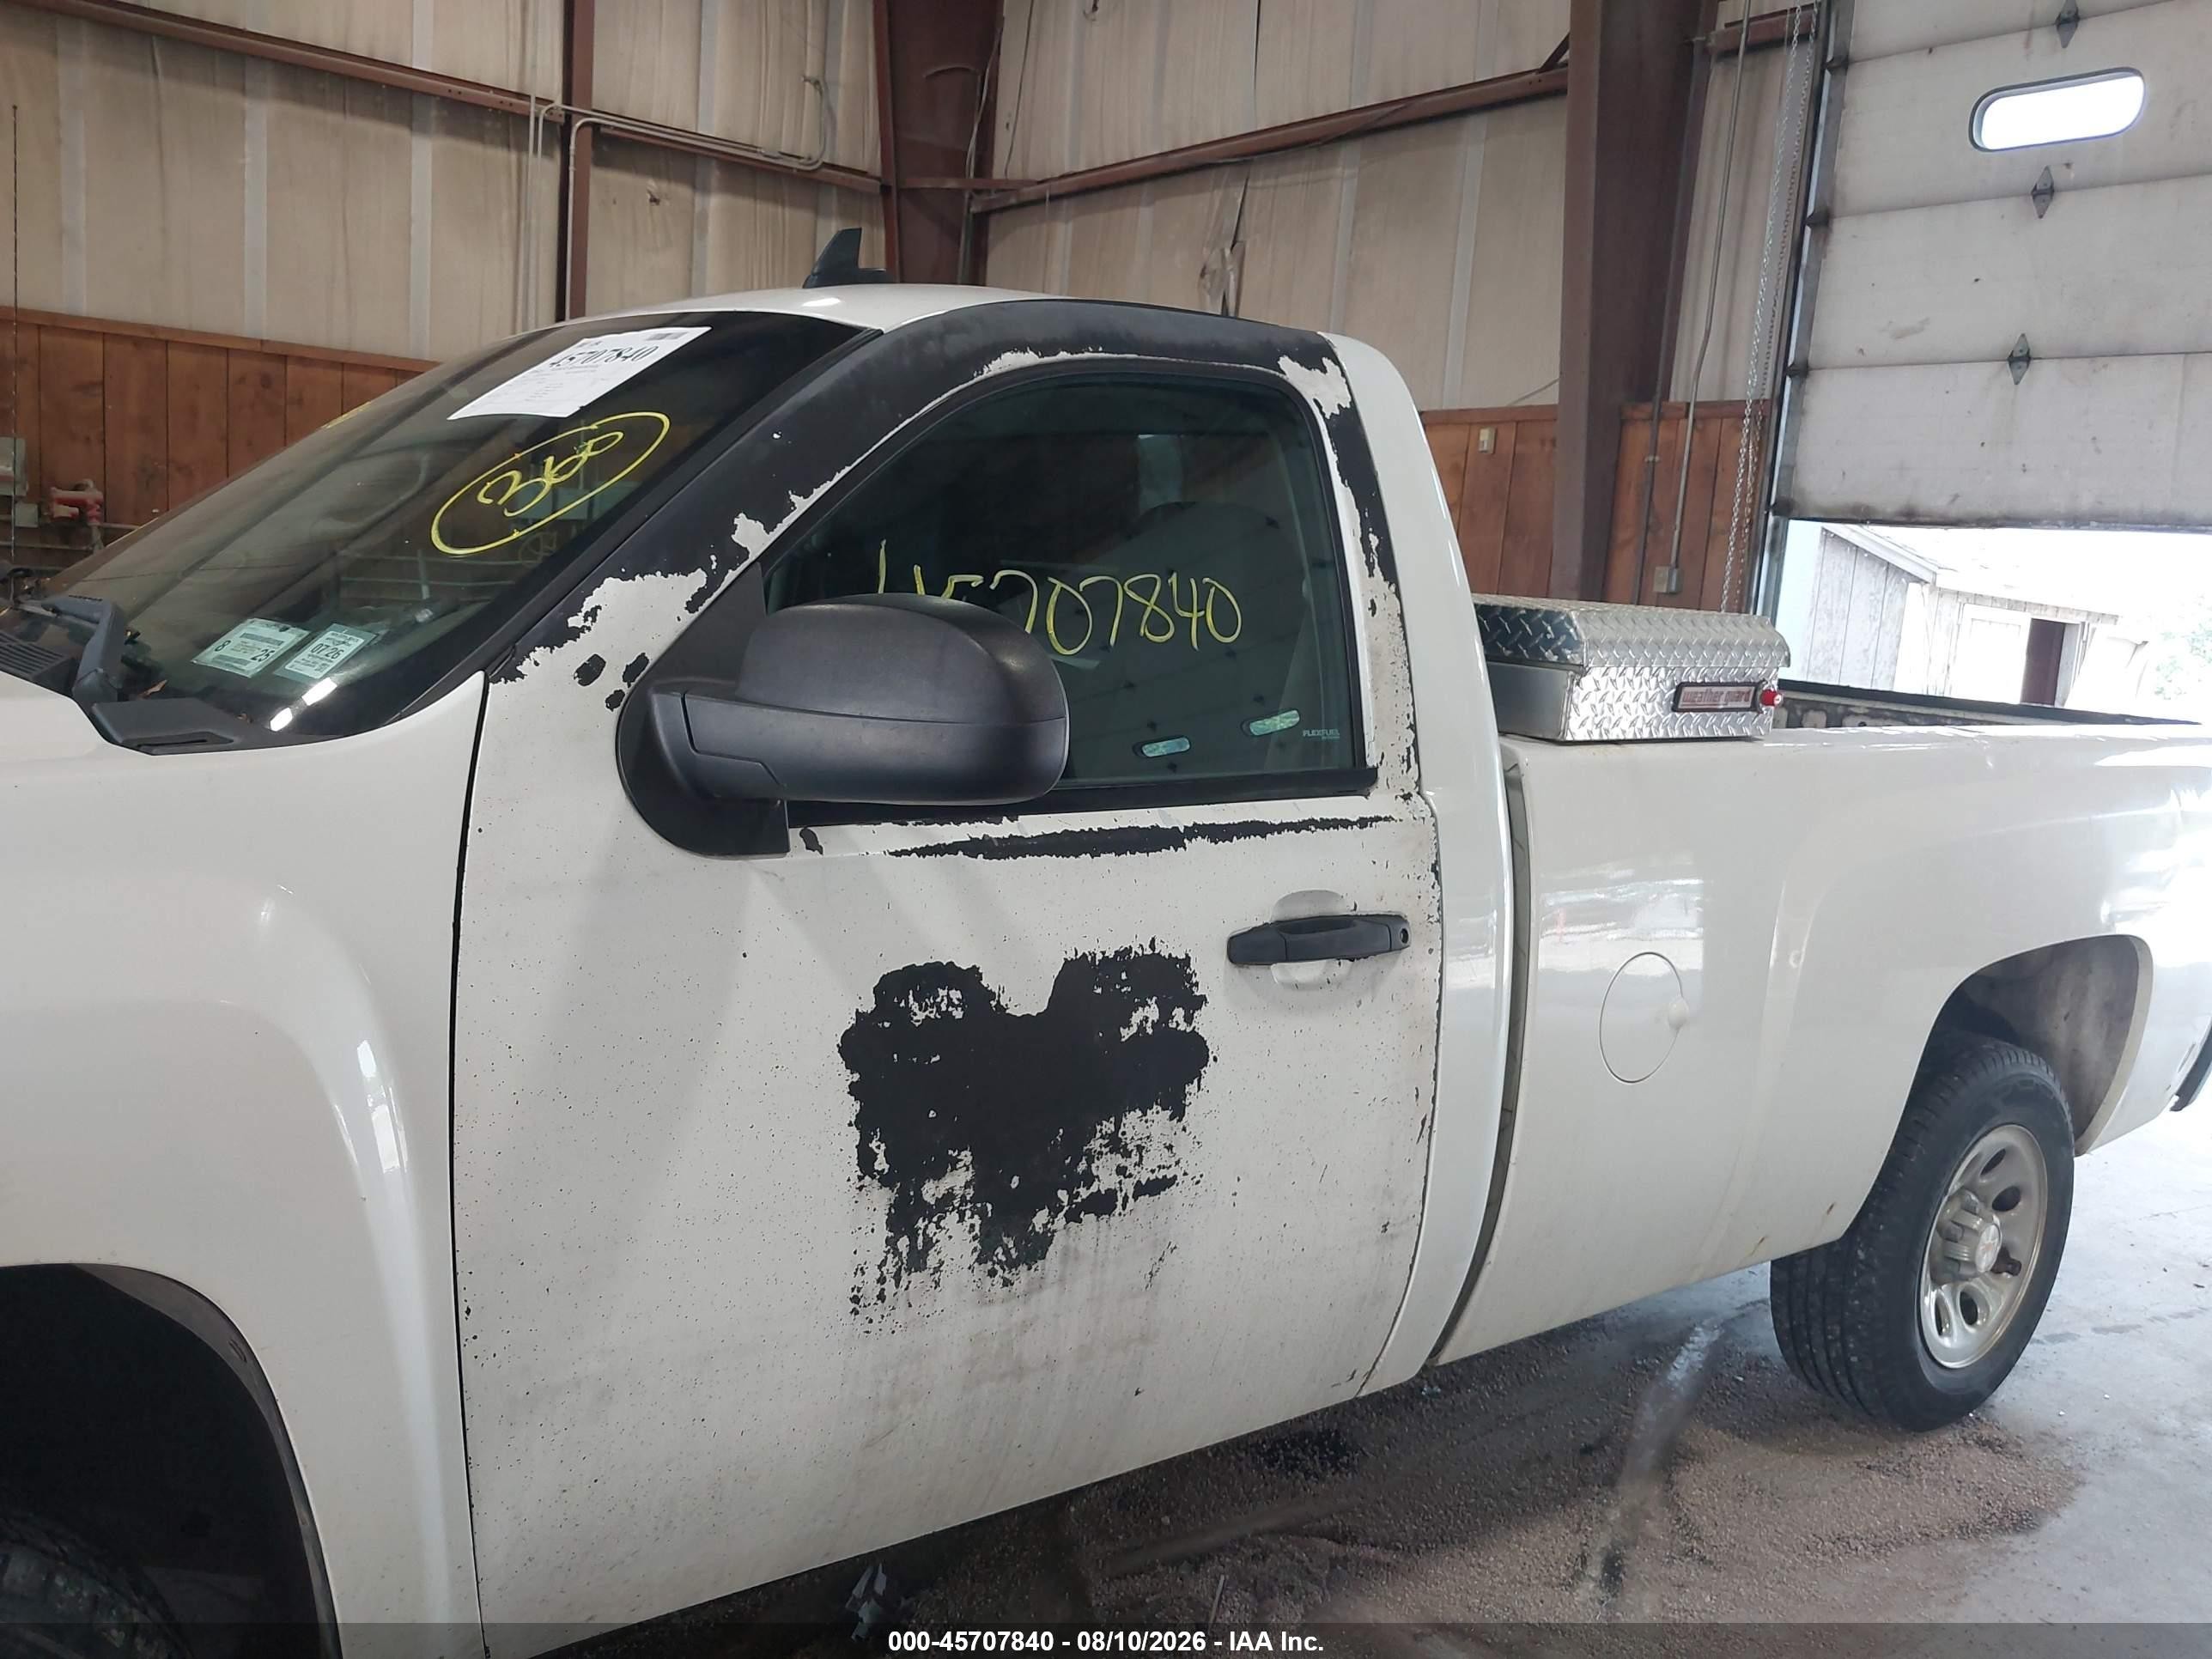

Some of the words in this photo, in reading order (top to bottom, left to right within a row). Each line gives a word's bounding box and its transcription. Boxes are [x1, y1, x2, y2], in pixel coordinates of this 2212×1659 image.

[550, 345, 659, 368] 45707840
[215, 640, 231, 652] 8
[251, 648, 275, 662] 25
[311, 643, 328, 653] 07
[328, 647, 344, 659] 26
